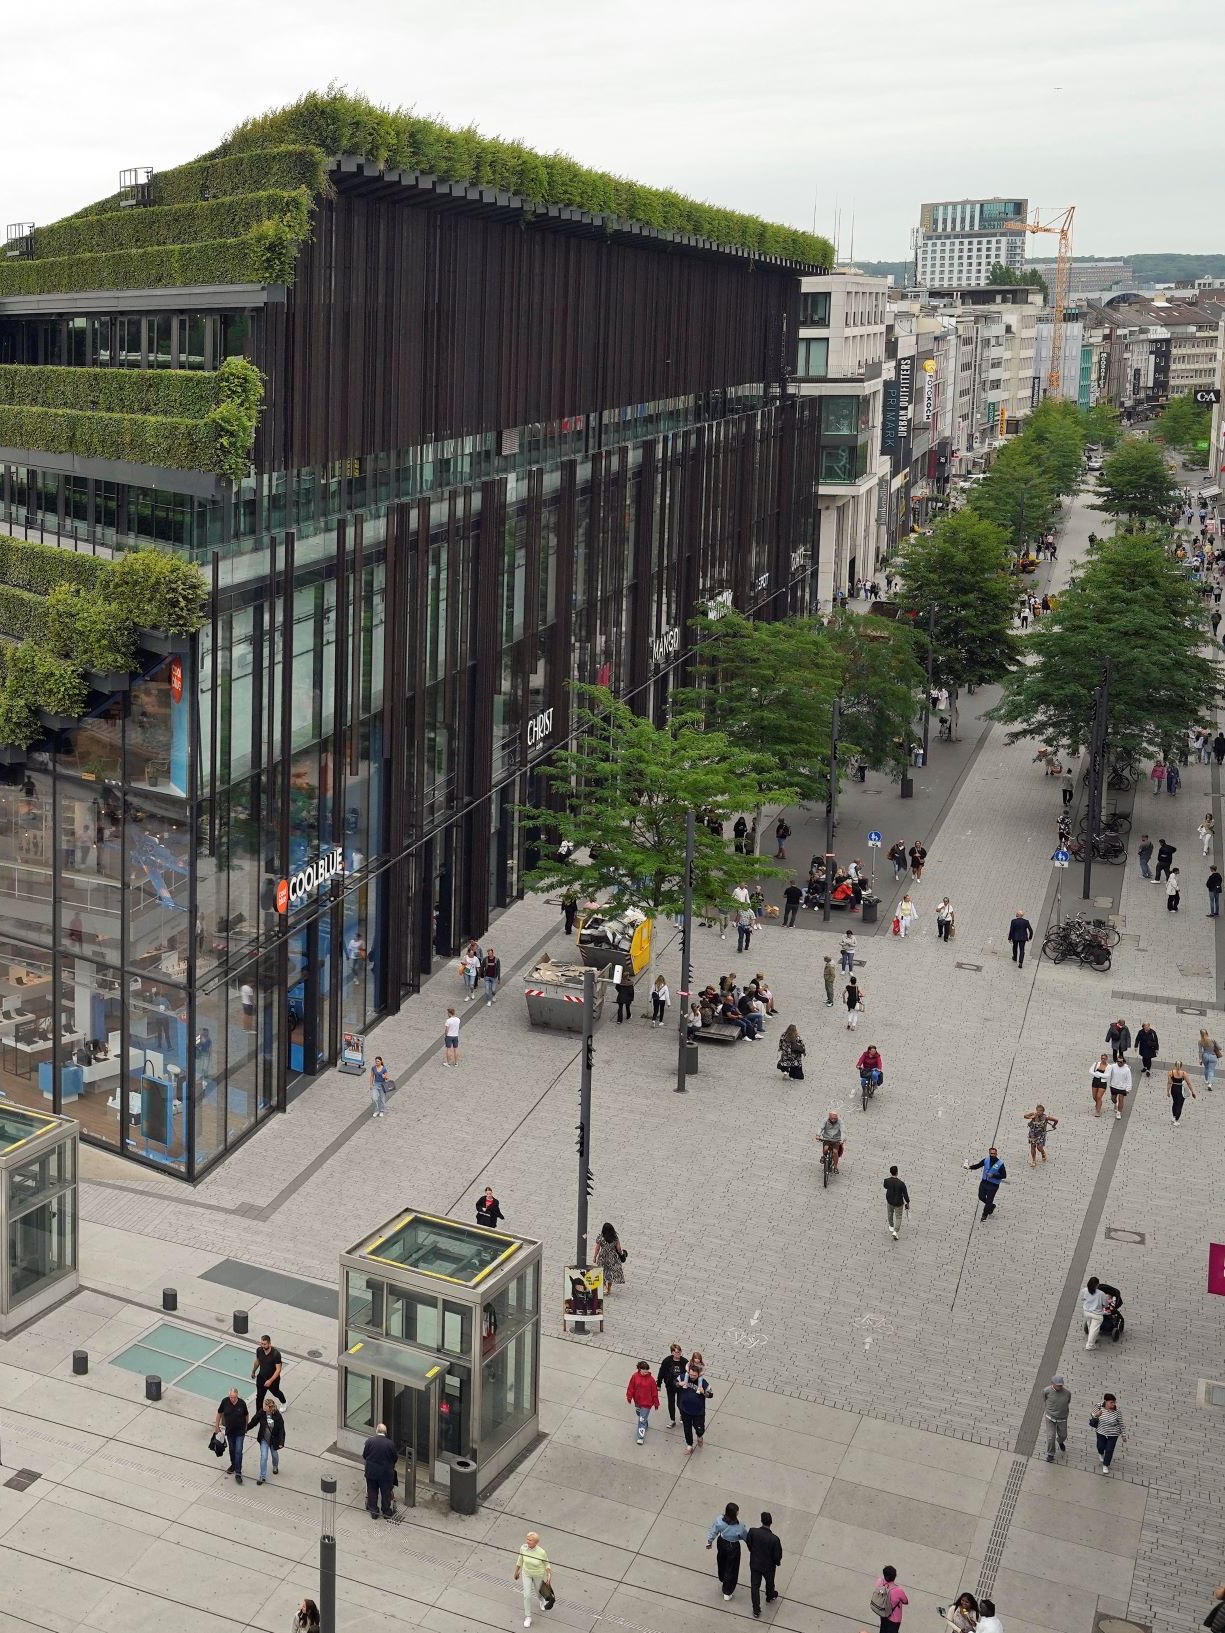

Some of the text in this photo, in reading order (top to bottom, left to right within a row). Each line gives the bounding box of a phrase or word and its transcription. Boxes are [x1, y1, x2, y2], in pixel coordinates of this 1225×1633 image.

[884, 389, 897, 447] PRIMARK
[898, 359, 911, 437] URBAN OUTFITTERS
[652, 628, 679, 662] MANGO
[527, 707, 554, 746] CHRIST
[289, 846, 343, 902] COOLBLUE
